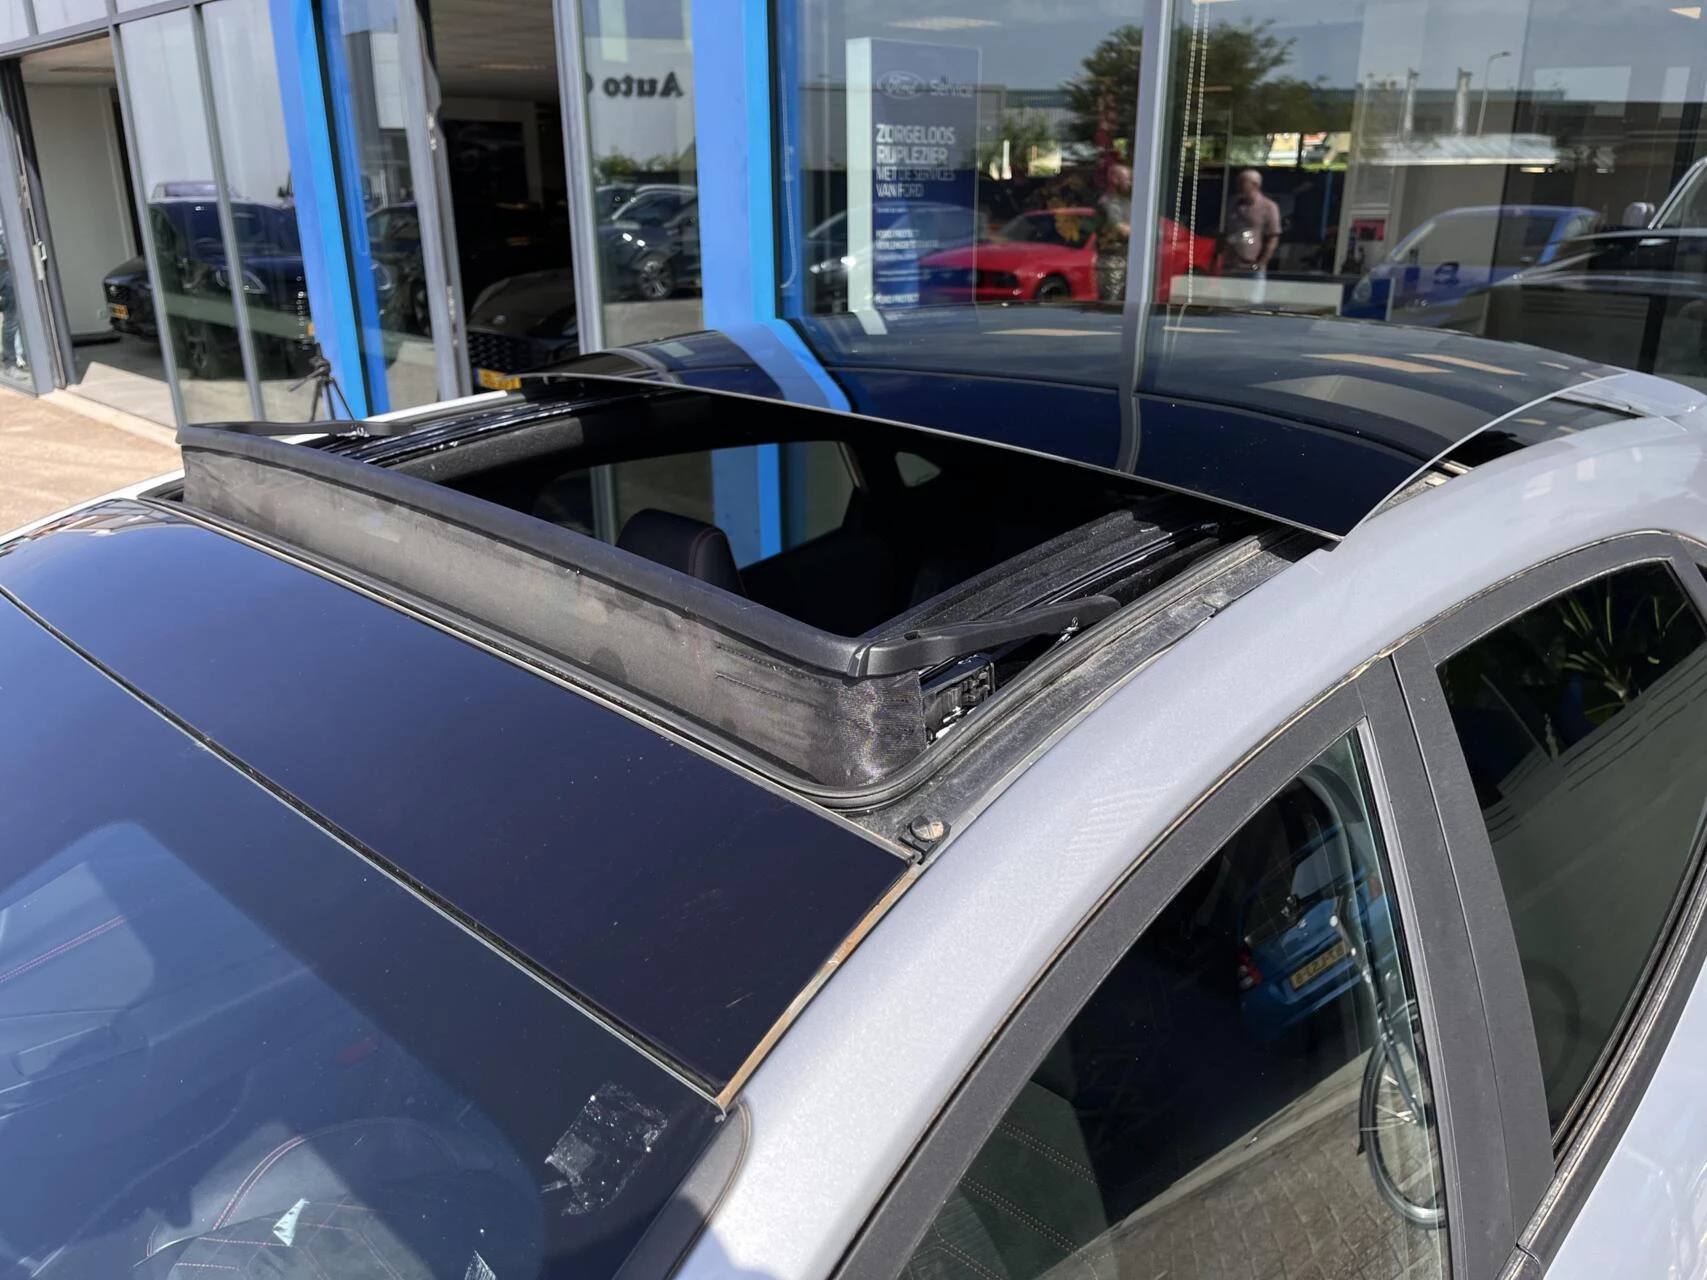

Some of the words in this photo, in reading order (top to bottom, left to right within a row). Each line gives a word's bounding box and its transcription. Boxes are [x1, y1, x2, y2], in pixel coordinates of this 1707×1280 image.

[876, 123, 956, 144] ZORGELOOS
[876, 166, 897, 181] MET
[876, 183, 896, 197] VAN
[898, 183, 924, 197] FORD
